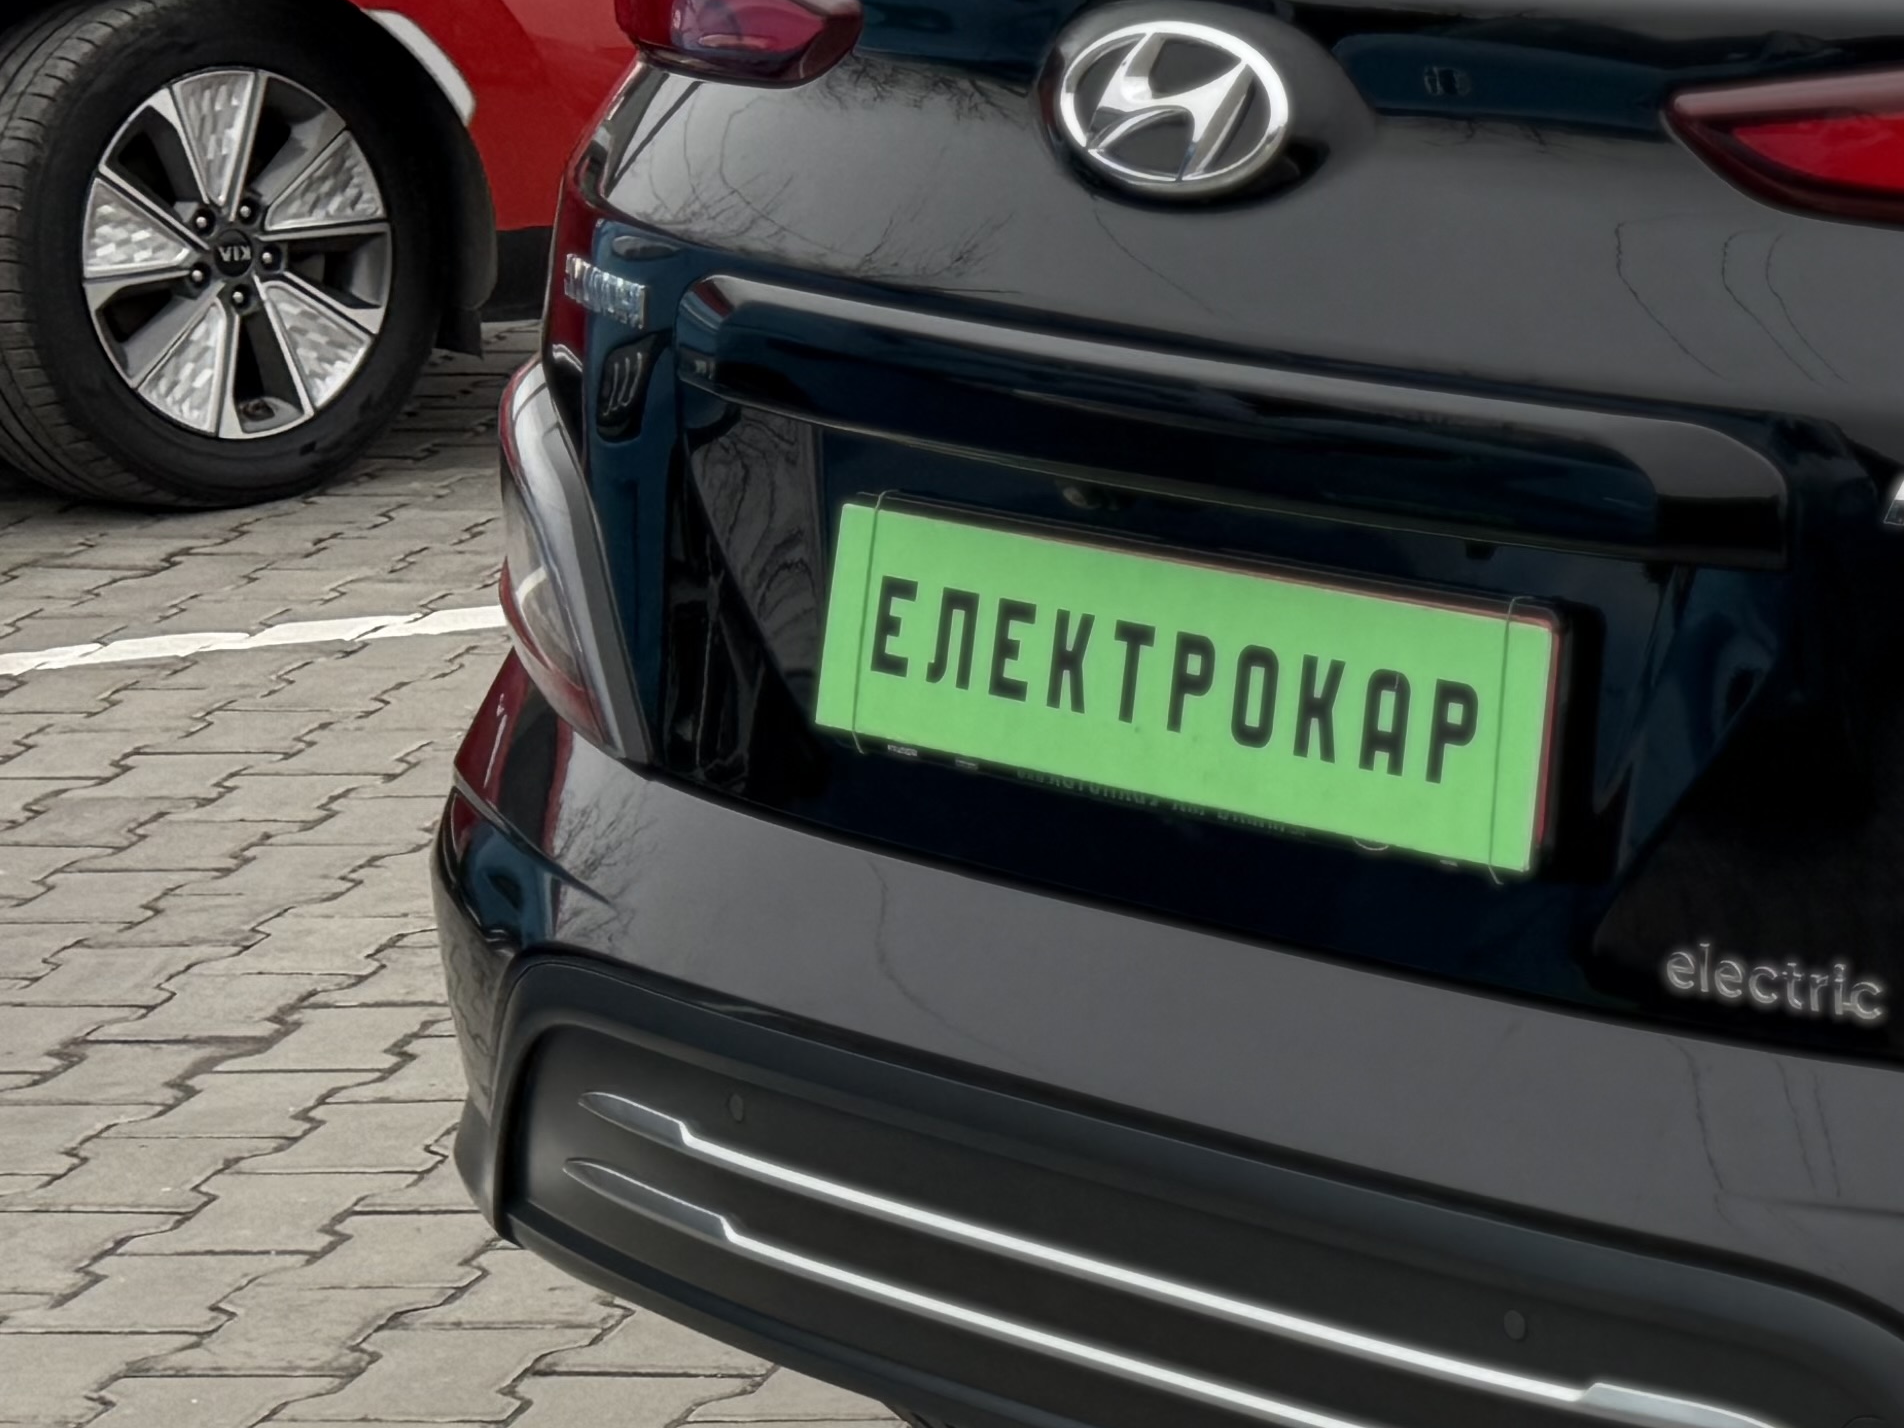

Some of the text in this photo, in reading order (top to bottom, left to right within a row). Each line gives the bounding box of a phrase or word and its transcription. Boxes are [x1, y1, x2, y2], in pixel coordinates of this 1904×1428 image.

[218, 246, 252, 262] KIA
[870, 574, 1480, 785] ЕЛЕКТРОКАР
[1666, 942, 1883, 1020] electric
